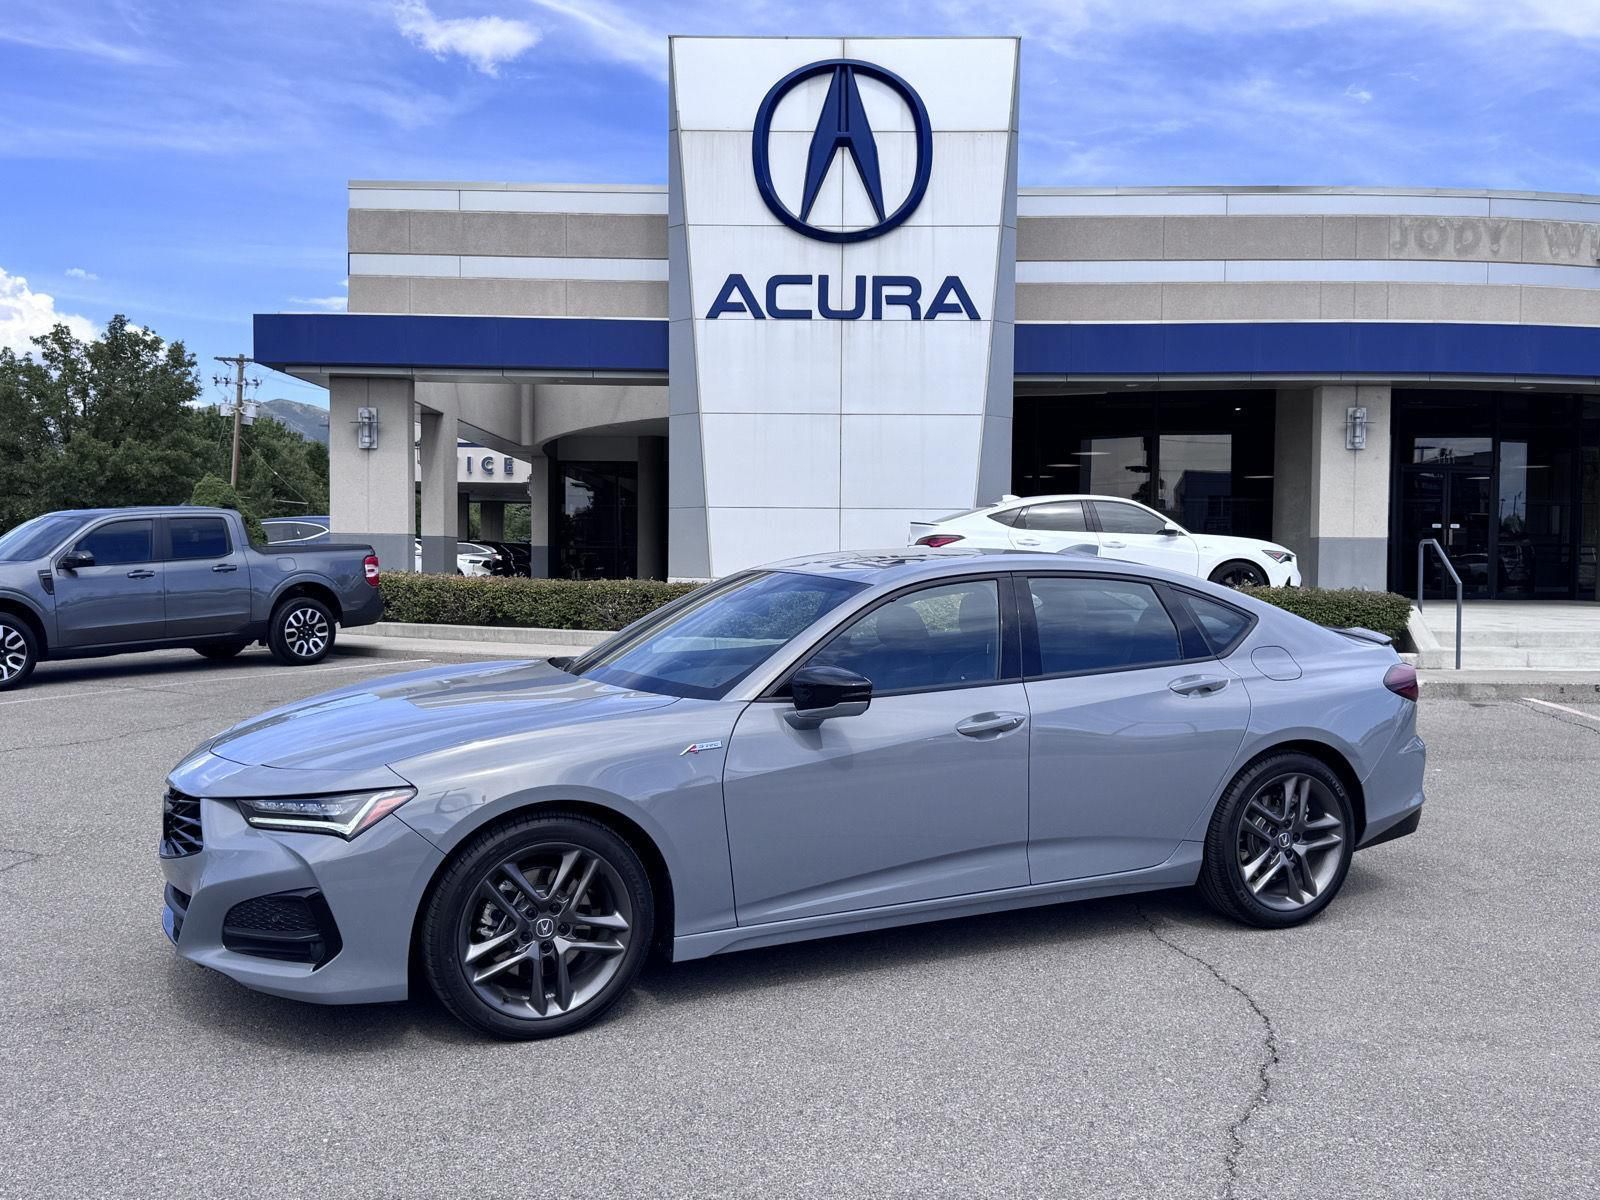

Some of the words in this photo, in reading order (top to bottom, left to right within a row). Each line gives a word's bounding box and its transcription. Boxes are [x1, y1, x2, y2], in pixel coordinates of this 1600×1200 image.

[1391, 217, 1509, 256] JODY
[706, 274, 981, 320] ACURA
[467, 457, 514, 475] ICE
